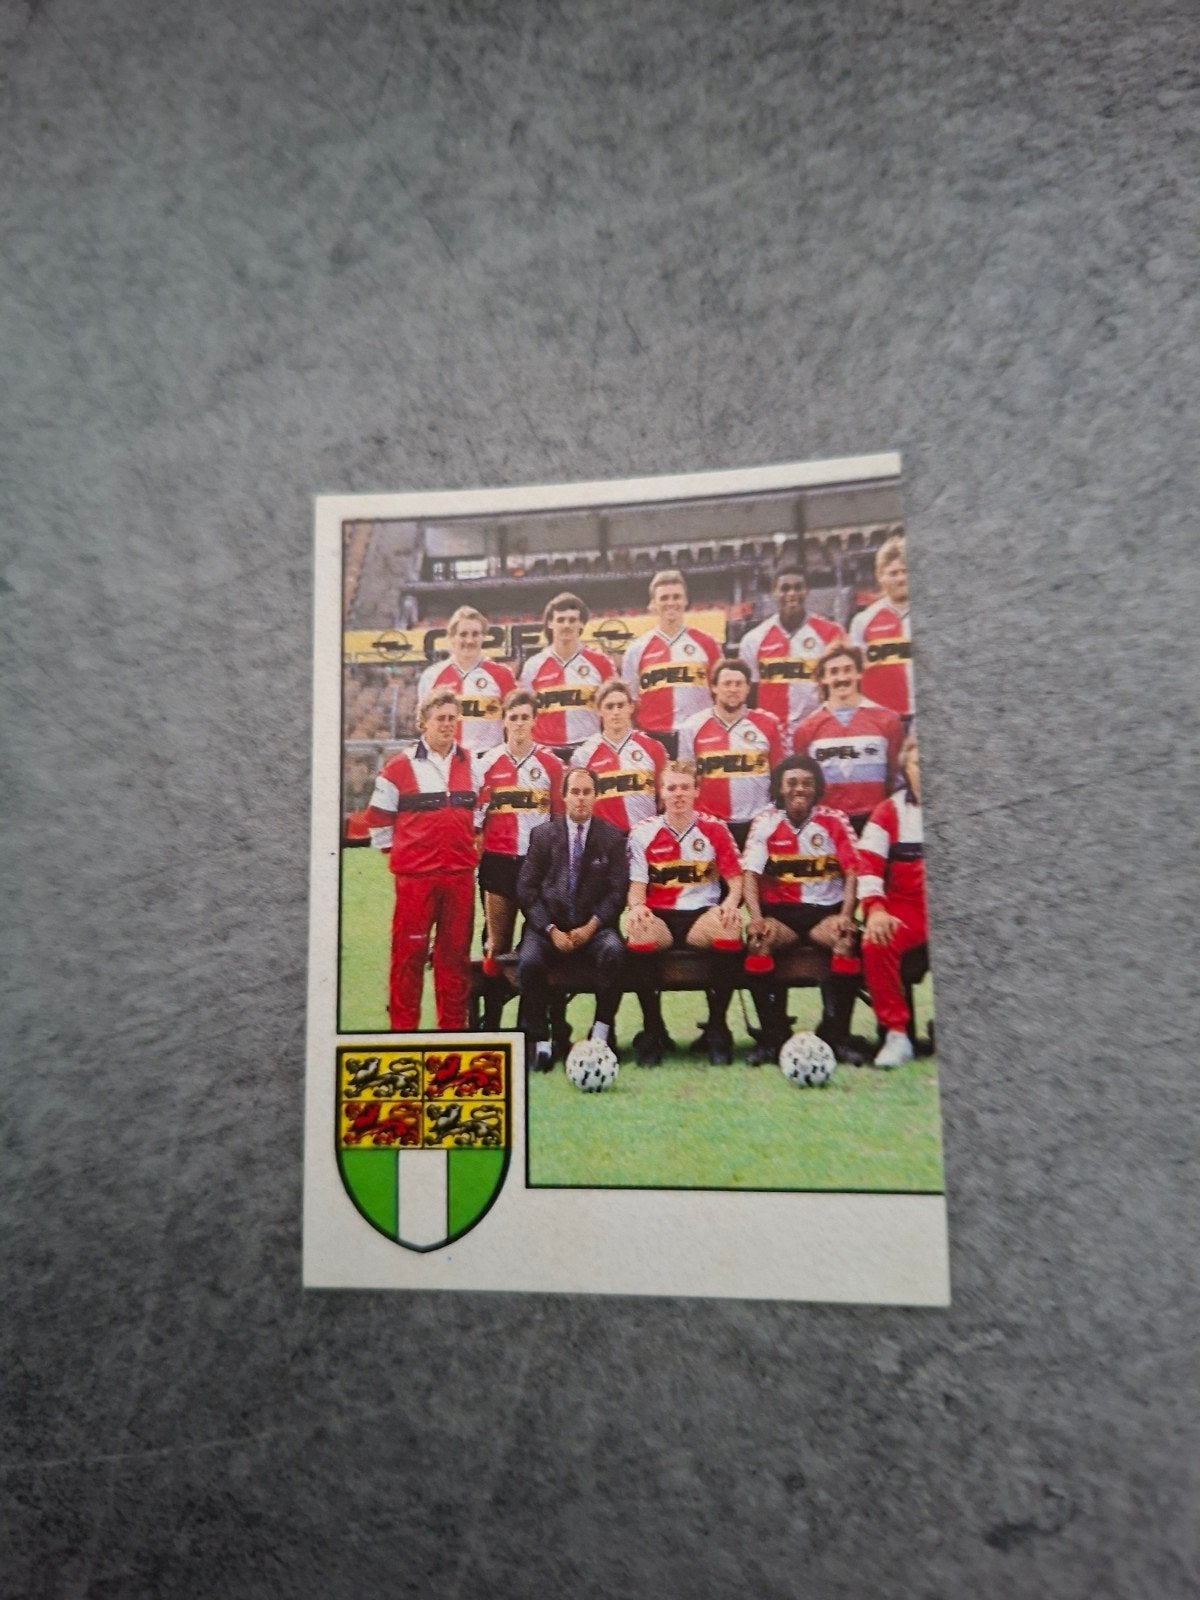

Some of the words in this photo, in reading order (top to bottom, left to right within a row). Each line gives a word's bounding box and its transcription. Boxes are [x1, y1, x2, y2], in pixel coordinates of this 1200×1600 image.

[640, 666, 694, 689] OPEL
[816, 745, 860, 762] OPEL
[648, 864, 702, 884] OPEL
